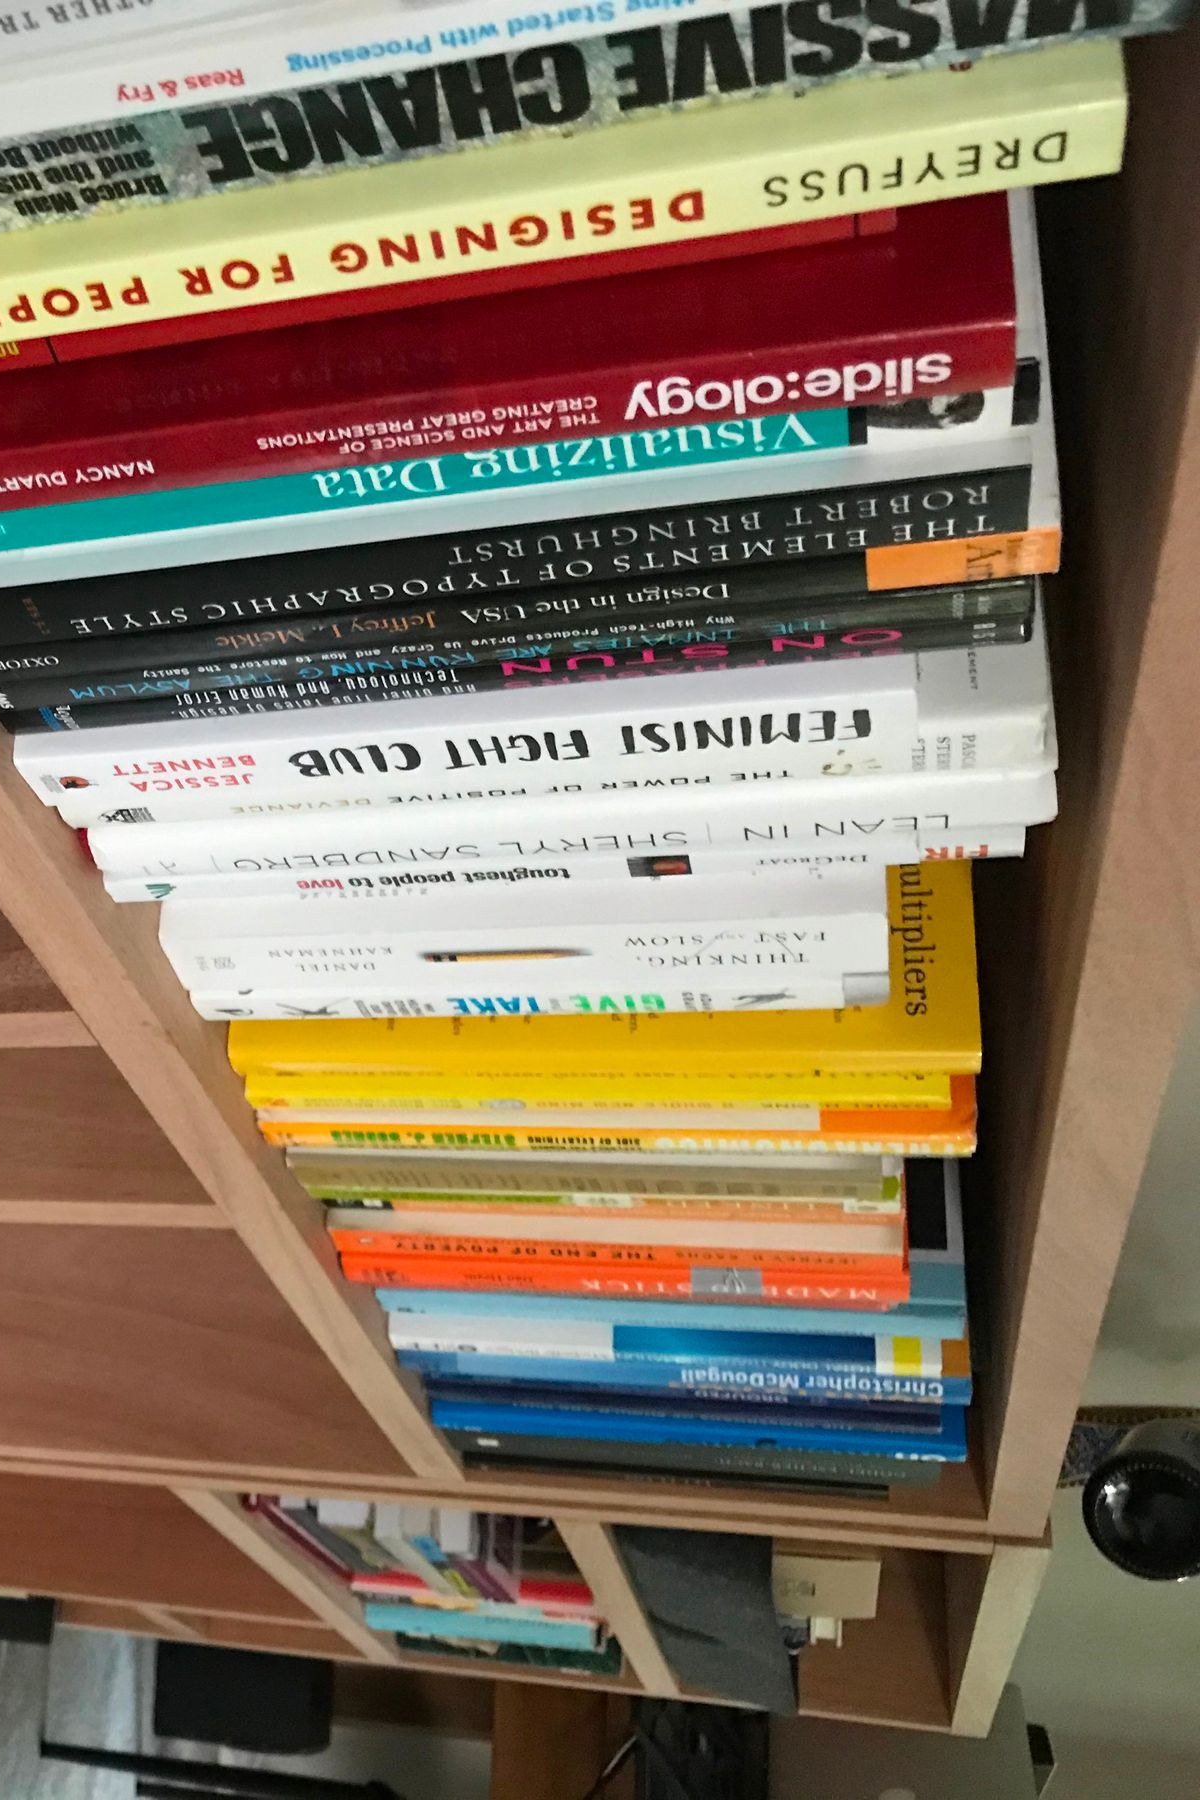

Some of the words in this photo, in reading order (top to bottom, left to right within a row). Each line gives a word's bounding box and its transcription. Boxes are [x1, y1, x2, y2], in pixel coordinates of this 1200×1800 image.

[507, 2, 615, 37] Started
[440, 21, 498, 48] with
[287, 32, 432, 74] Processing
[161, 79, 177, 97] &
[183, 67, 244, 92] Reas
[116, 79, 155, 104] Fry
[181, 44, 589, 184] CHANGE
[32, 123, 145, 163] without
[101, 151, 154, 179] and
[763, 131, 1067, 208] DREYFUSS
[46, 163, 95, 193] the
[83, 173, 167, 206] Bruce
[14, 188, 77, 218] Mau
[330, 190, 705, 274] DESIGNING
[180, 254, 294, 295] FOR
[623, 352, 953, 423] slide:ology
[493, 395, 598, 420] CREATING
[407, 409, 485, 429] GREAT
[460, 421, 505, 438] AND
[512, 416, 554, 433] ART
[560, 412, 600, 428] THE
[257, 415, 401, 451] PRESENTATIONS
[370, 428, 456, 449] SCIENCE
[338, 441, 366, 453] OF
[470, 412, 818, 481] Visualizing
[74, 459, 155, 487] NANCY
[312, 460, 450, 499] Data
[785, 485, 991, 528] ROBERT
[449, 511, 760, 566] BRINGHURST
[891, 515, 995, 543] THE
[613, 529, 867, 574] ELEMENTS
[537, 559, 593, 583] OF
[200, 566, 520, 621] TYPOGRAPHIC
[590, 594, 616, 611] in
[626, 583, 730, 605] Design
[459, 604, 527, 624] USA
[534, 598, 582, 618] the
[70, 607, 188, 635] STYLE
[351, 610, 438, 637] Jeffrey
[609, 618, 694, 634] High-Tech
[705, 613, 736, 626] Why
[215, 627, 305, 651] Meikle
[471, 635, 515, 648] Drive
[526, 628, 598, 643] Products
[572, 627, 734, 651] INMATES
[772, 629, 902, 652] ON
[320, 652, 346, 662] How
[356, 649, 381, 660] and
[391, 642, 434, 656] Crazy
[197, 664, 220, 674] the
[230, 658, 286, 671] Restore
[297, 651, 475, 679] RUNNING
[502, 645, 728, 677] STUN
[143, 666, 189, 679] Sanity
[337, 668, 460, 691] Technology,
[69, 677, 191, 699] ASYLUM
[175, 690, 221, 706] Error
[228, 684, 287, 700] Human
[297, 682, 330, 696] And
[617, 709, 872, 756] FEMINIST
[288, 742, 421, 778] CLUB
[445, 729, 590, 770] FIGHT
[112, 753, 256, 777] BENNETT
[129, 772, 254, 793] JESSICA
[601, 776, 710, 790] POWER
[729, 770, 790, 784] THE
[389, 788, 526, 805] POSITIVE
[544, 784, 582, 794] OF
[230, 798, 372, 815] DEVIANCE
[744, 824, 788, 841] IN
[814, 814, 949, 838] LEAN
[500, 831, 687, 856] SHERYL
[233, 844, 480, 872] SANDBERG
[296, 878, 344, 891] love
[349, 876, 373, 890] to
[379, 869, 456, 889] people
[462, 868, 570, 885] toughest
[623, 935, 702, 947] SLOW
[754, 931, 826, 942] FAST
[268, 947, 391, 959] KAHNEMAN
[636, 953, 810, 967] THINKING,
[295, 962, 376, 973] DANIEL
[447, 996, 540, 1014] TAKE
[570, 994, 666, 1013] GIVE
[681, 1366, 800, 1388] McDougall
[804, 1373, 944, 1397] Christopher
